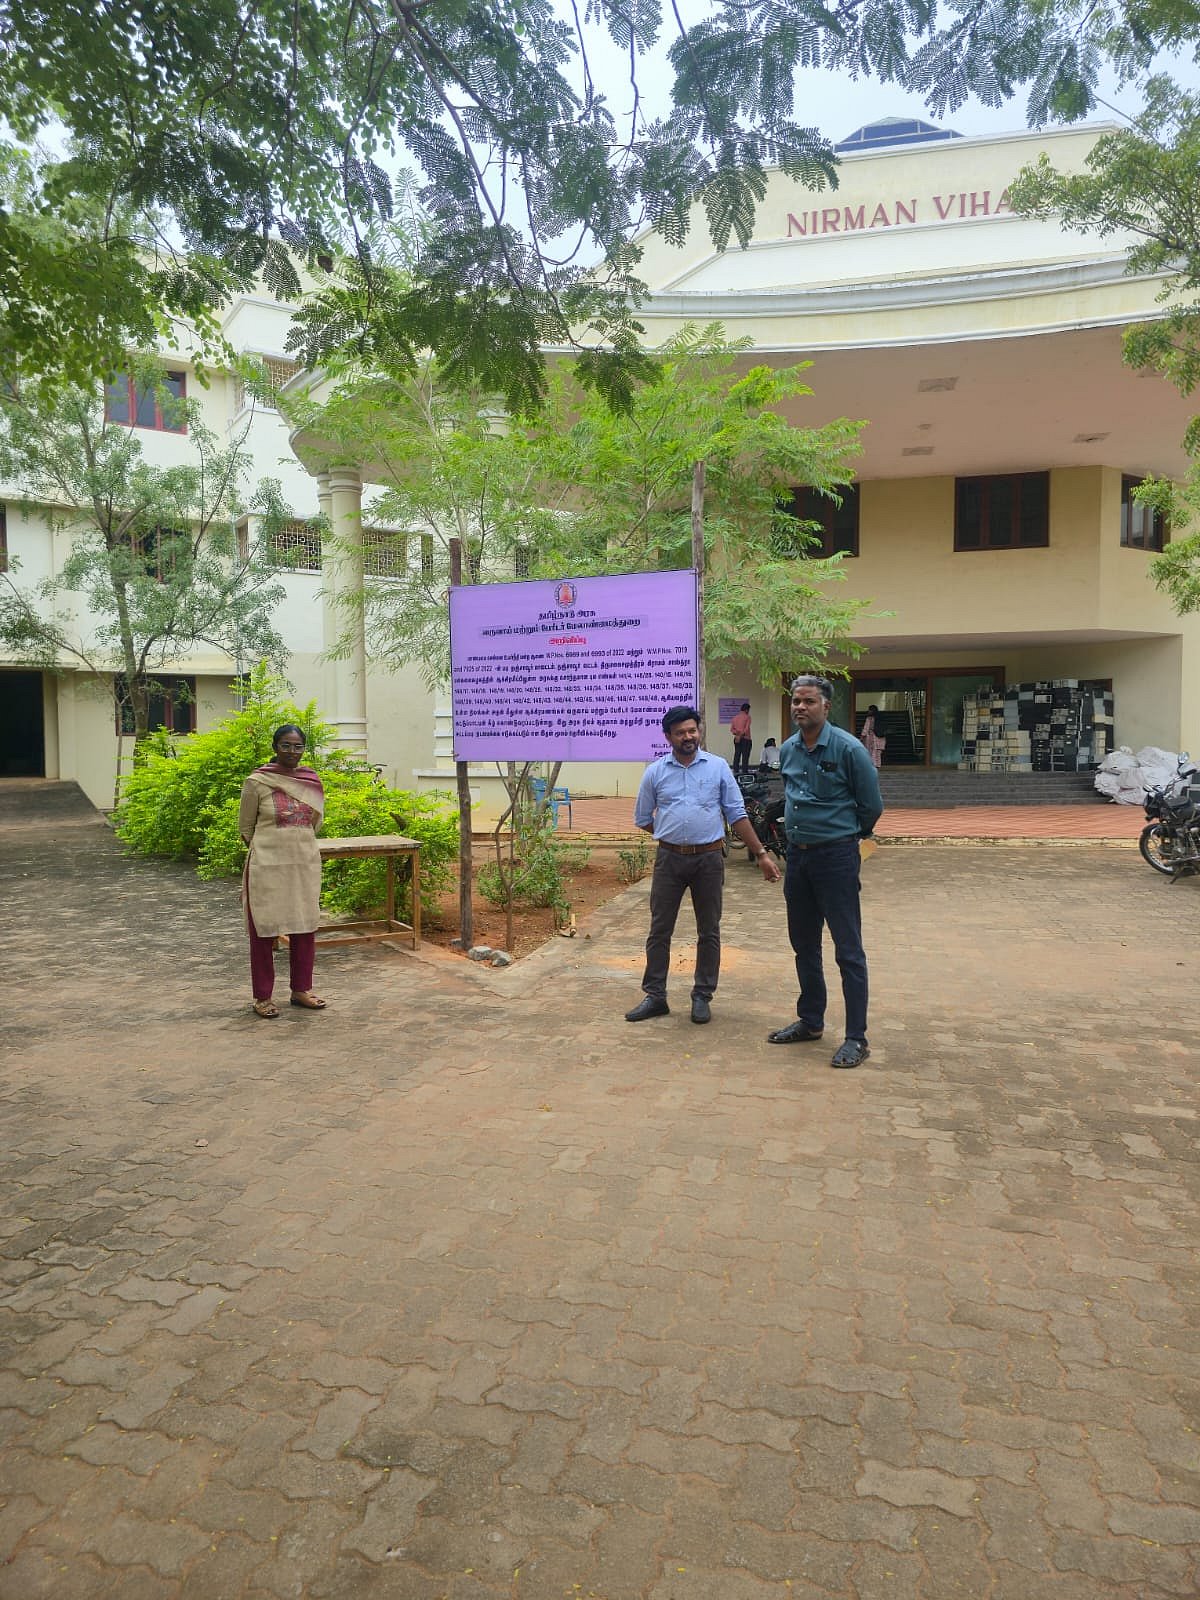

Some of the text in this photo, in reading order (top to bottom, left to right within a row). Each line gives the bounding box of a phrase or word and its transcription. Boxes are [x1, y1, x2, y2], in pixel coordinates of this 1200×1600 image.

[786, 187, 1018, 237] NIRMAN VIHA
[513, 624, 538, 635] மற்றும்
